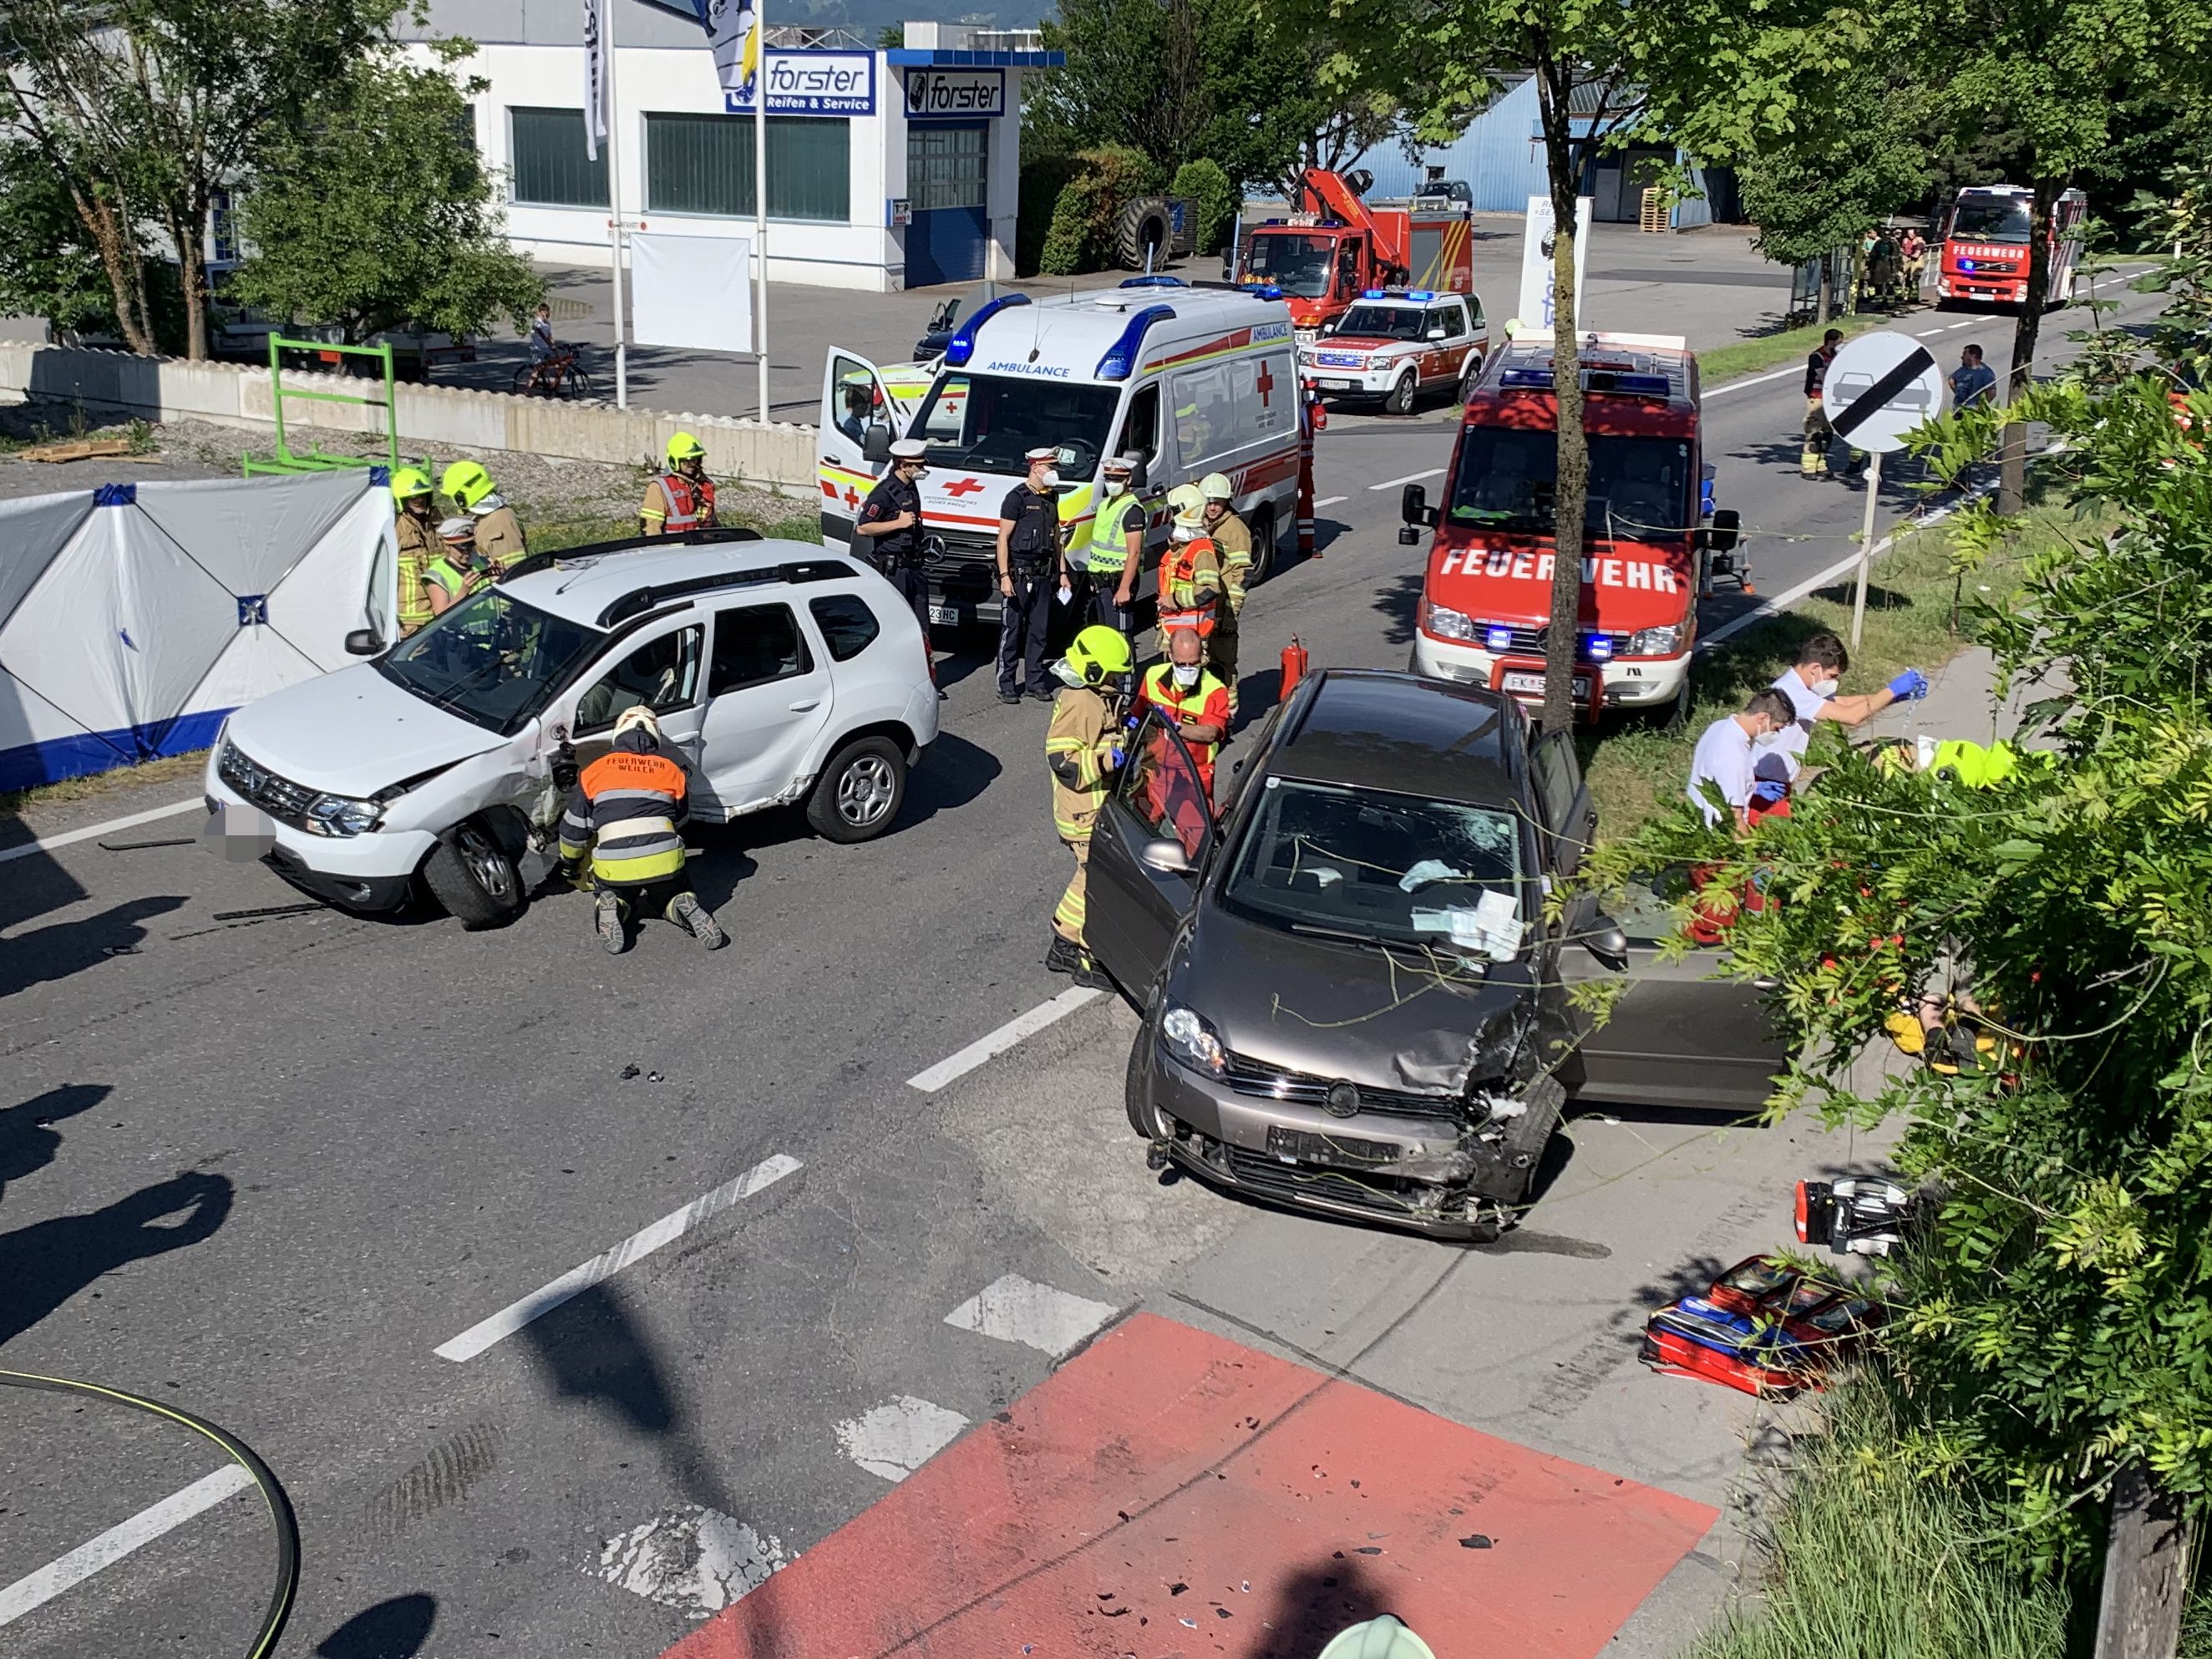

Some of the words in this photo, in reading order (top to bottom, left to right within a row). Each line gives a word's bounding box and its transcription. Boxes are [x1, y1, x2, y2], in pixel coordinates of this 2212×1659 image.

[770, 59, 864, 92] forster
[930, 75, 999, 109] forster
[766, 96, 806, 109] Reifen
[810, 98, 819, 109] &
[823, 98, 870, 110] Service
[1952, 245, 2025, 259] FEUERWEHR
[1253, 323, 1288, 342] AMBULANCE
[987, 362, 1070, 378] AMBULANCE
[1512, 677, 1527, 689] FK
[606, 758, 666, 770] FEUERWEHR
[618, 764, 655, 774] WEILER
